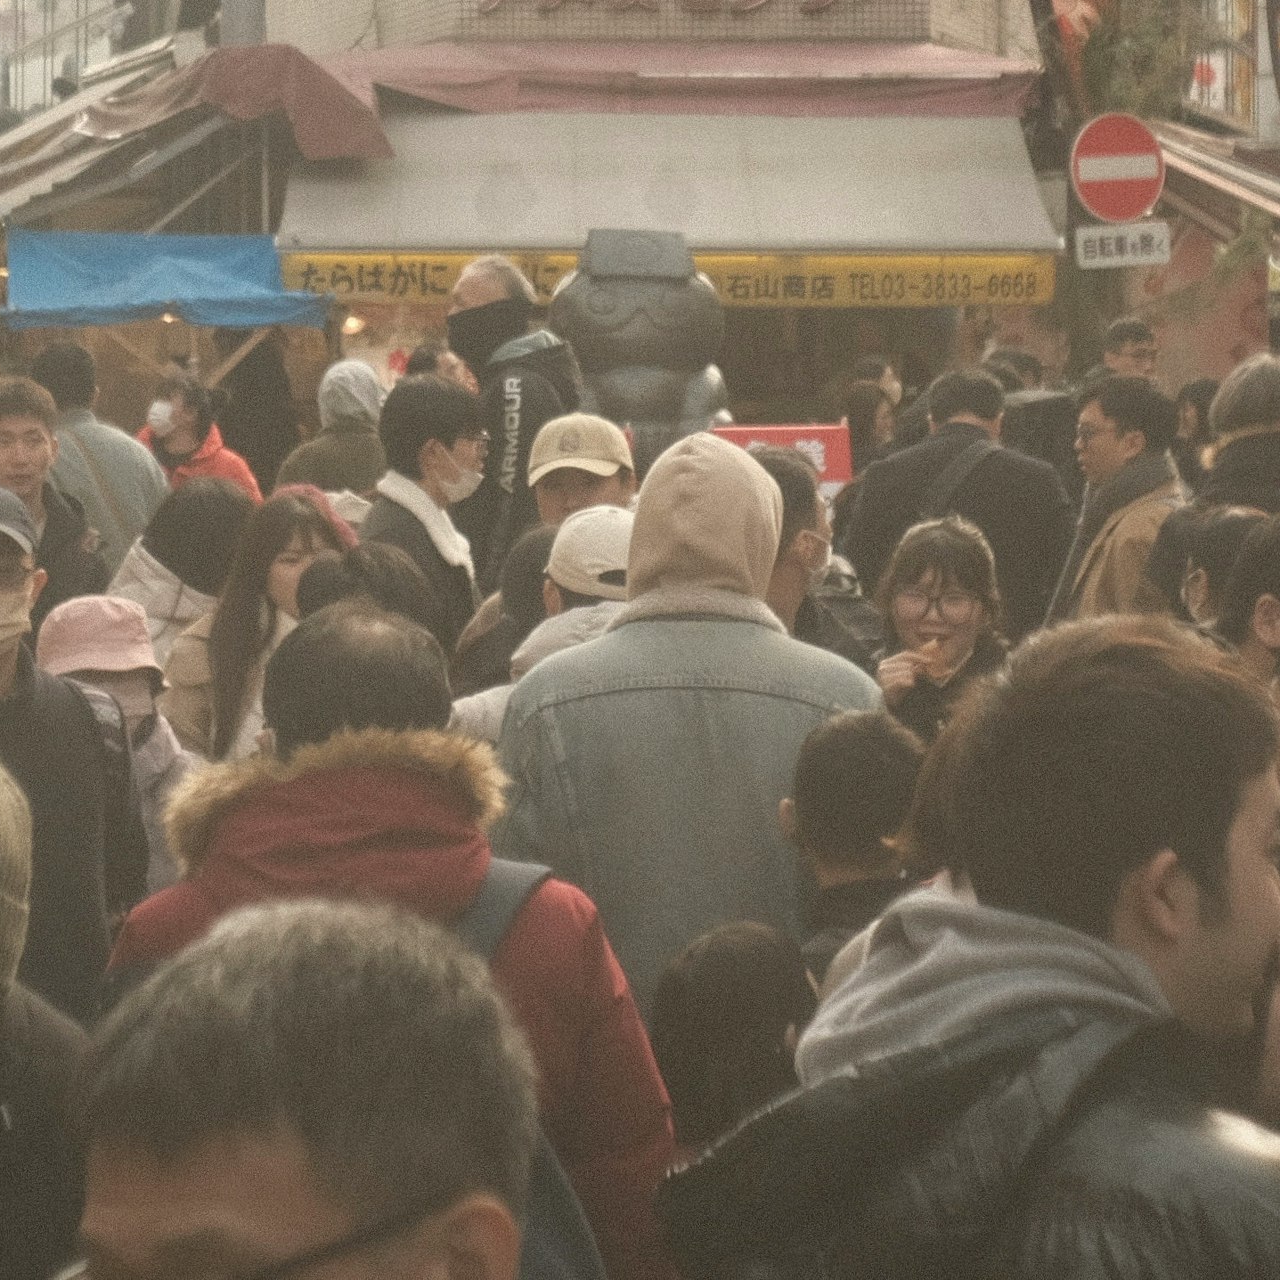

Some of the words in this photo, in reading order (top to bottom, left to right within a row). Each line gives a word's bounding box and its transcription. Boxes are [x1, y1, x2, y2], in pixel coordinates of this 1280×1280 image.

[301, 262, 449, 296] たらばがに
[727, 273, 835, 300] 石山商店
[499, 376, 523, 494] ARMOUR
